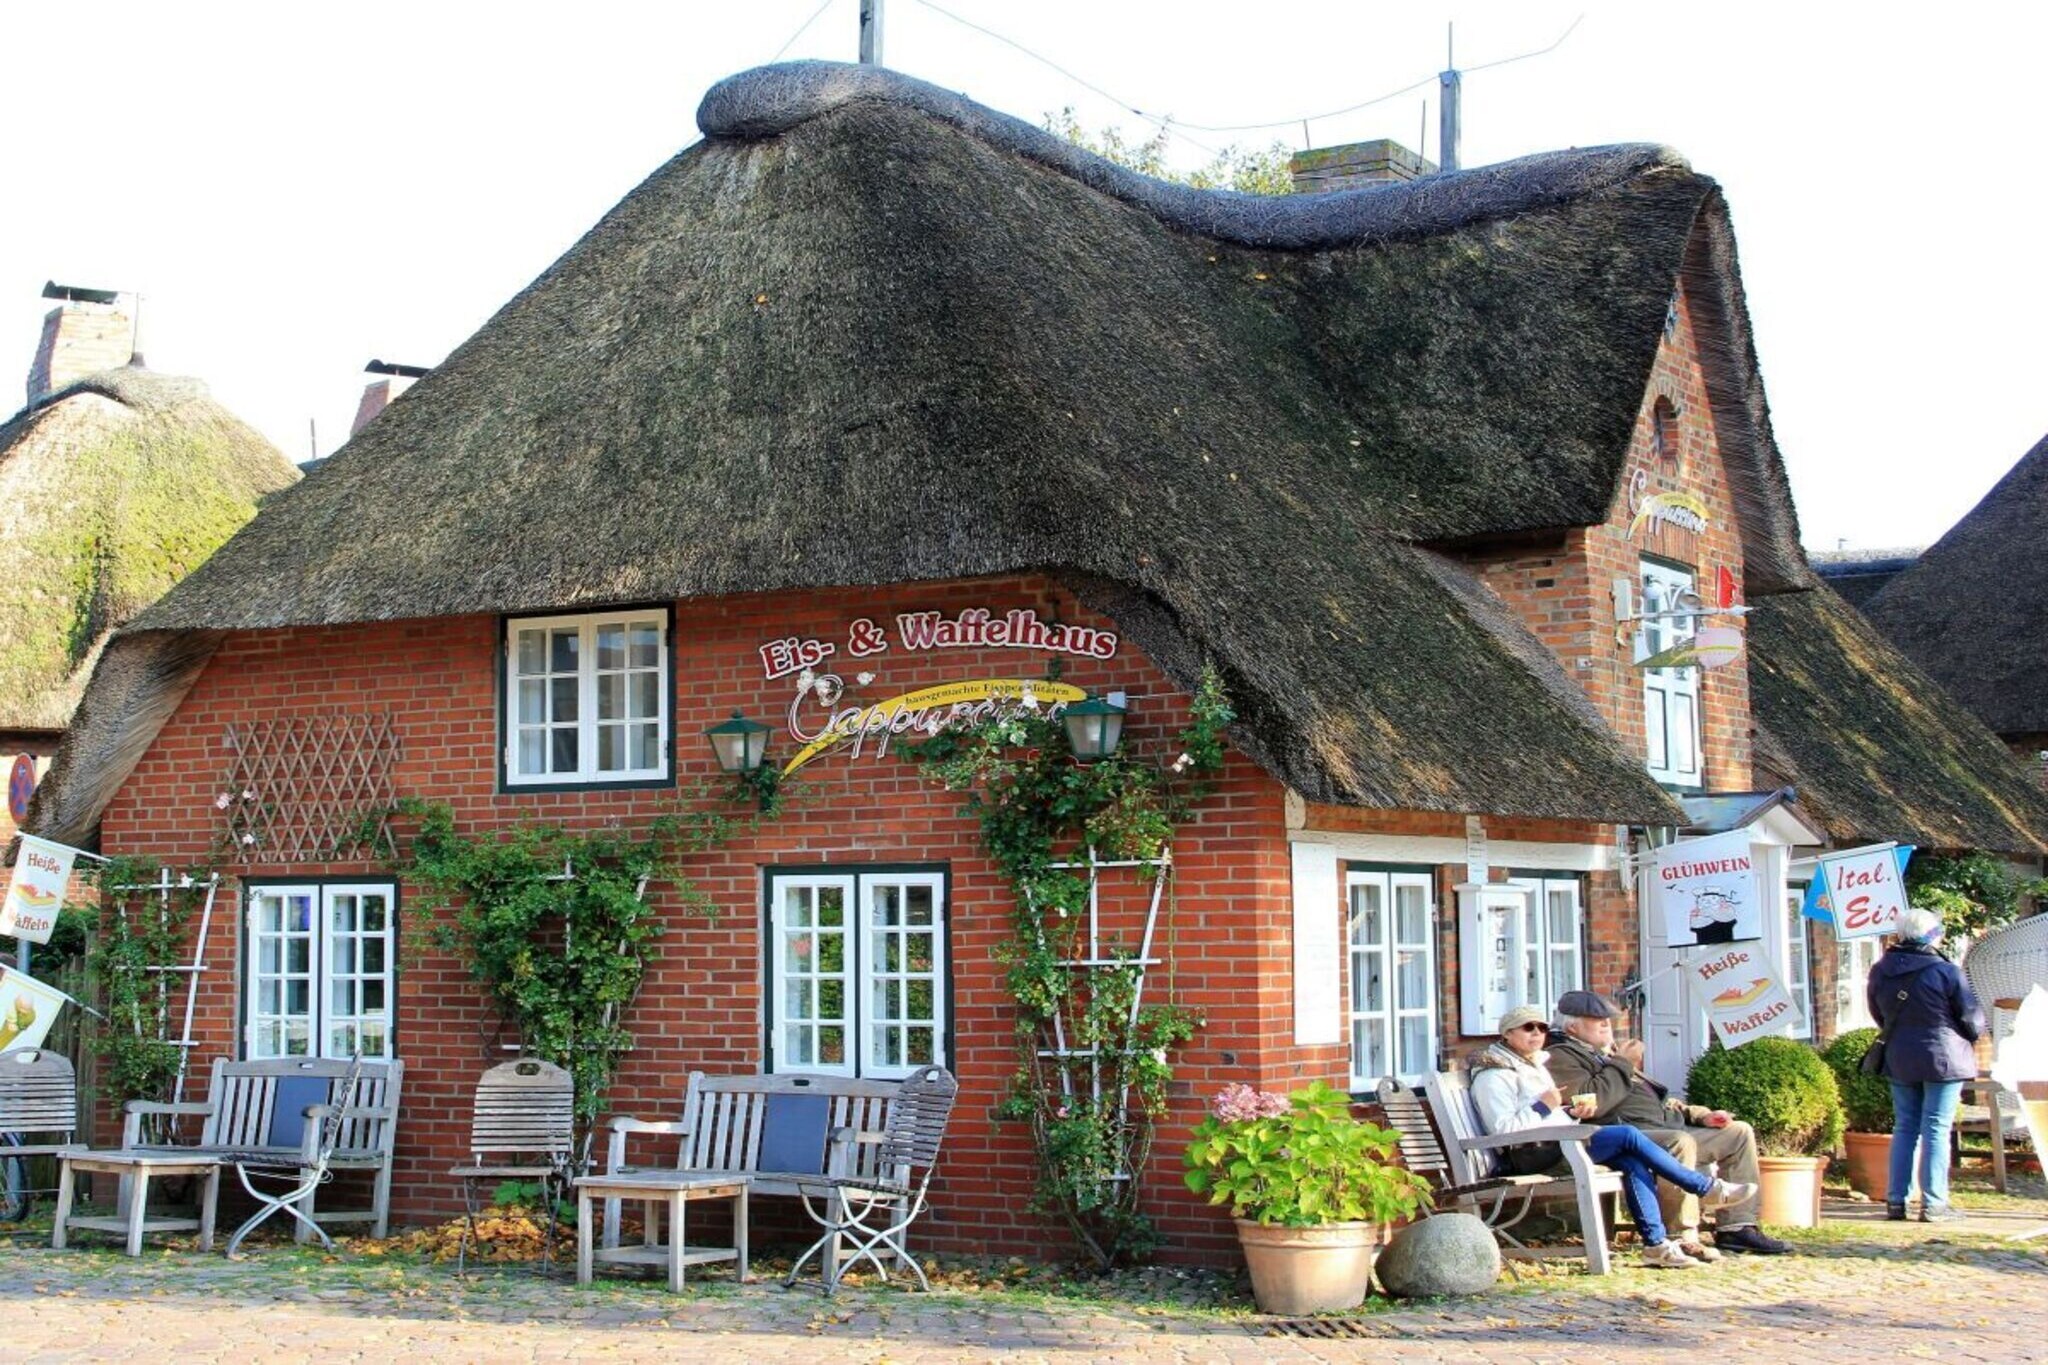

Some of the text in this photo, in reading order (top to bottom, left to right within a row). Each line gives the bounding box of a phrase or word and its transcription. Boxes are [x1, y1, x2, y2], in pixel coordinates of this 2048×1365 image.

[760, 608, 1118, 680] Eis- & Waffelhaus
[27, 853, 61, 874] Heiße
[1662, 856, 1750, 880] GLÜHWEIN
[1837, 863, 1891, 891] Ital.
[1845, 896, 1899, 929] Eis
[1698, 952, 1751, 980] Heiße
[1722, 1001, 1788, 1035] Waffeln
